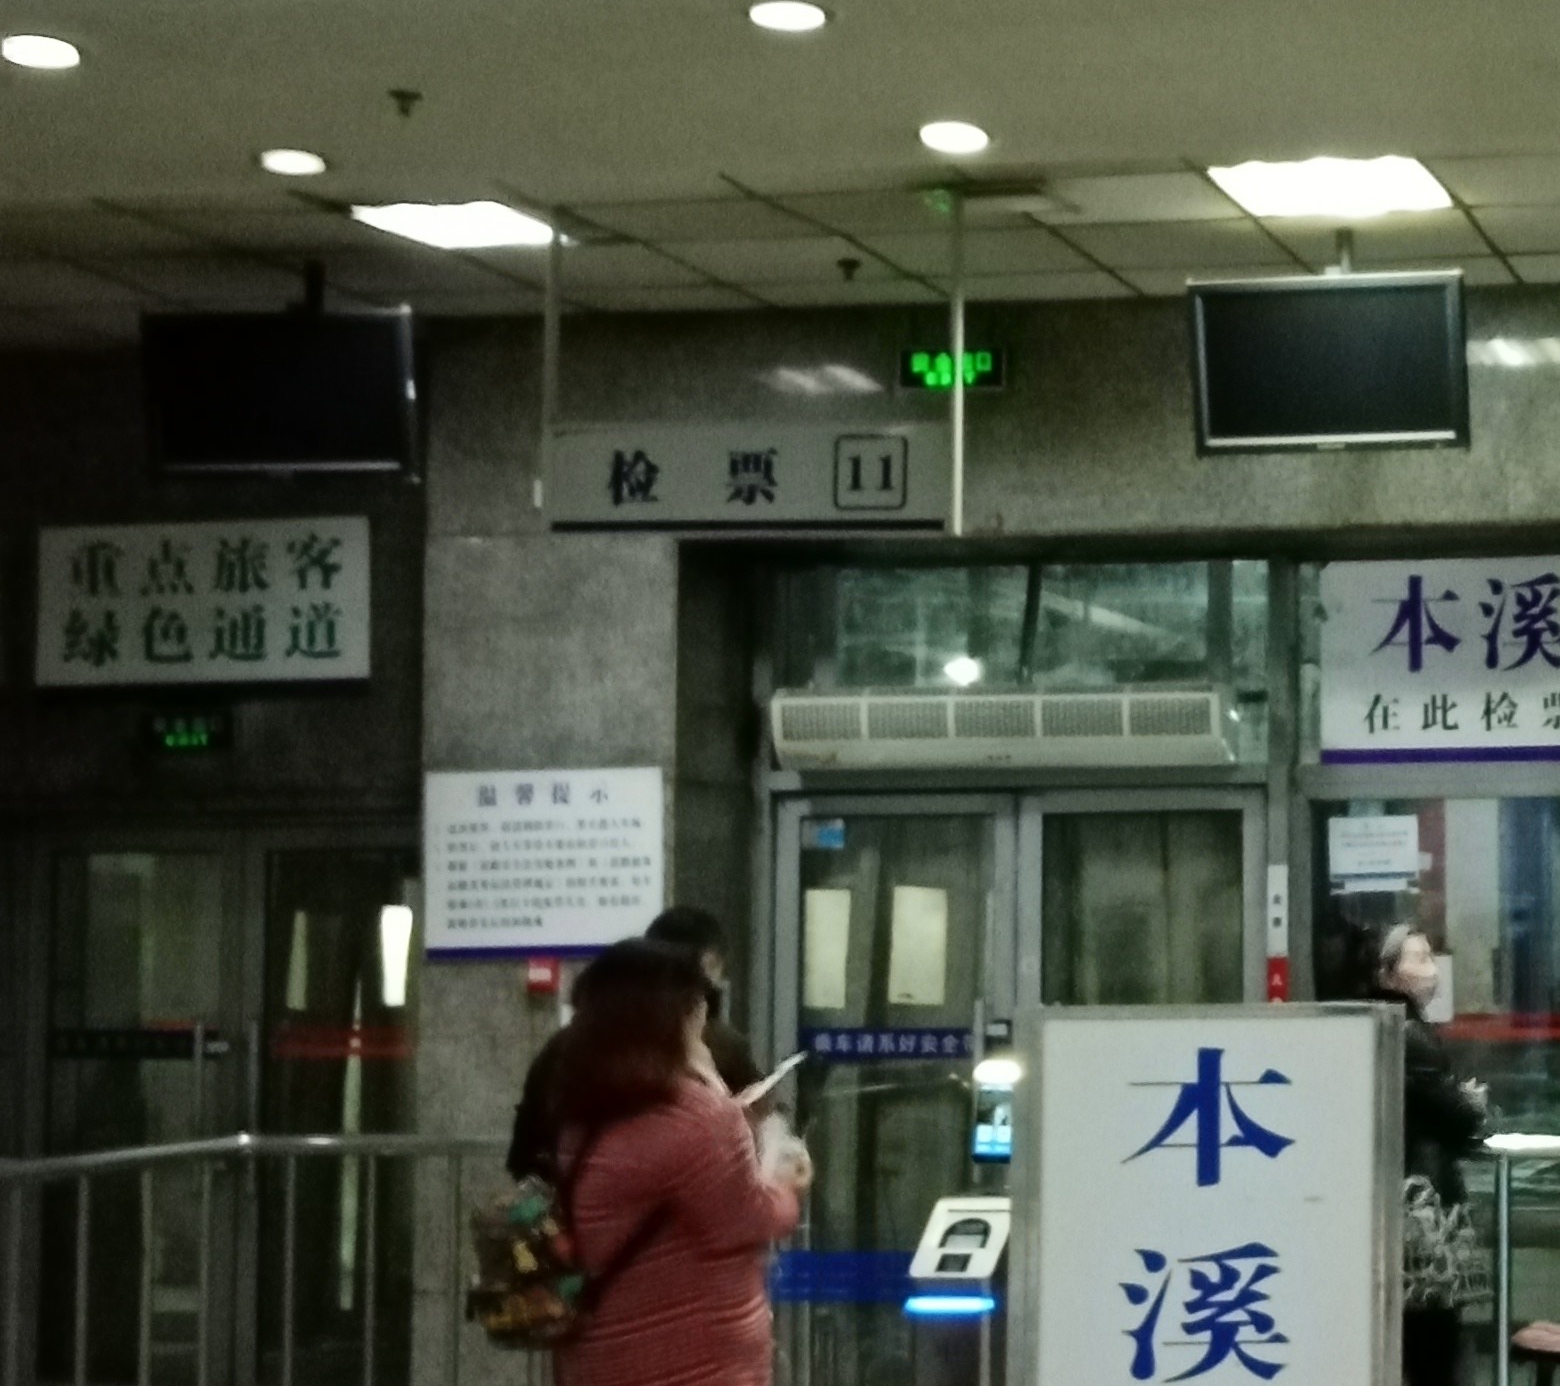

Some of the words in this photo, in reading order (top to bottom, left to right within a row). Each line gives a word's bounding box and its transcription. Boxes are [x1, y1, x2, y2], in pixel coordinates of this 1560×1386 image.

[608, 448, 779, 507] 检票
[847, 454, 895, 492] 11
[66, 532, 343, 598] 重点旅客
[62, 601, 343, 668] 绿色通道
[1119, 1046, 1297, 1384] 本溪
